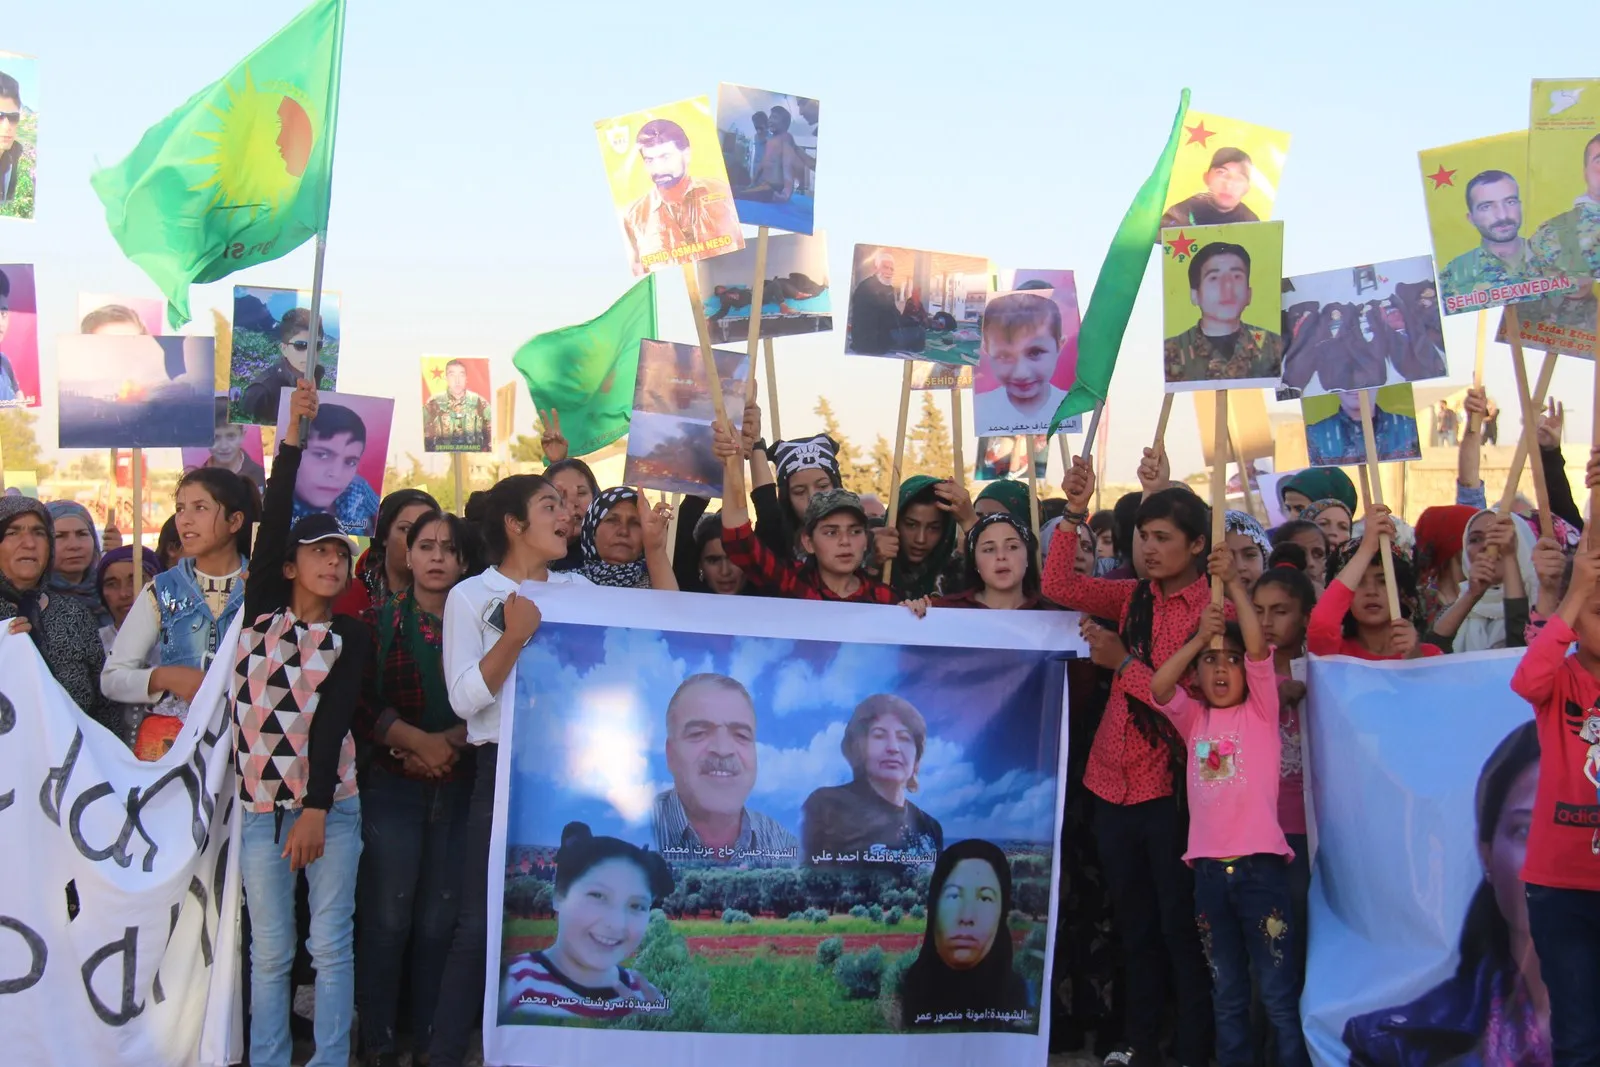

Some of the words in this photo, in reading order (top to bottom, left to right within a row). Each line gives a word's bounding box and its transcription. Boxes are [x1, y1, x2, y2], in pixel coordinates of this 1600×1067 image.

[671, 242, 704, 258] OSMAN
[1490, 277, 1571, 301] BEXWEDAN
[663, 845, 690, 854] محمد
[693, 845, 715, 857] عزت
[718, 845, 735, 858] حاج
[811, 849, 833, 864] علي
[835, 850, 859, 862] احمد
[518, 994, 548, 1005] محمد
[914, 1011, 932, 1023] عمر
[933, 1011, 963, 1023] منصور
